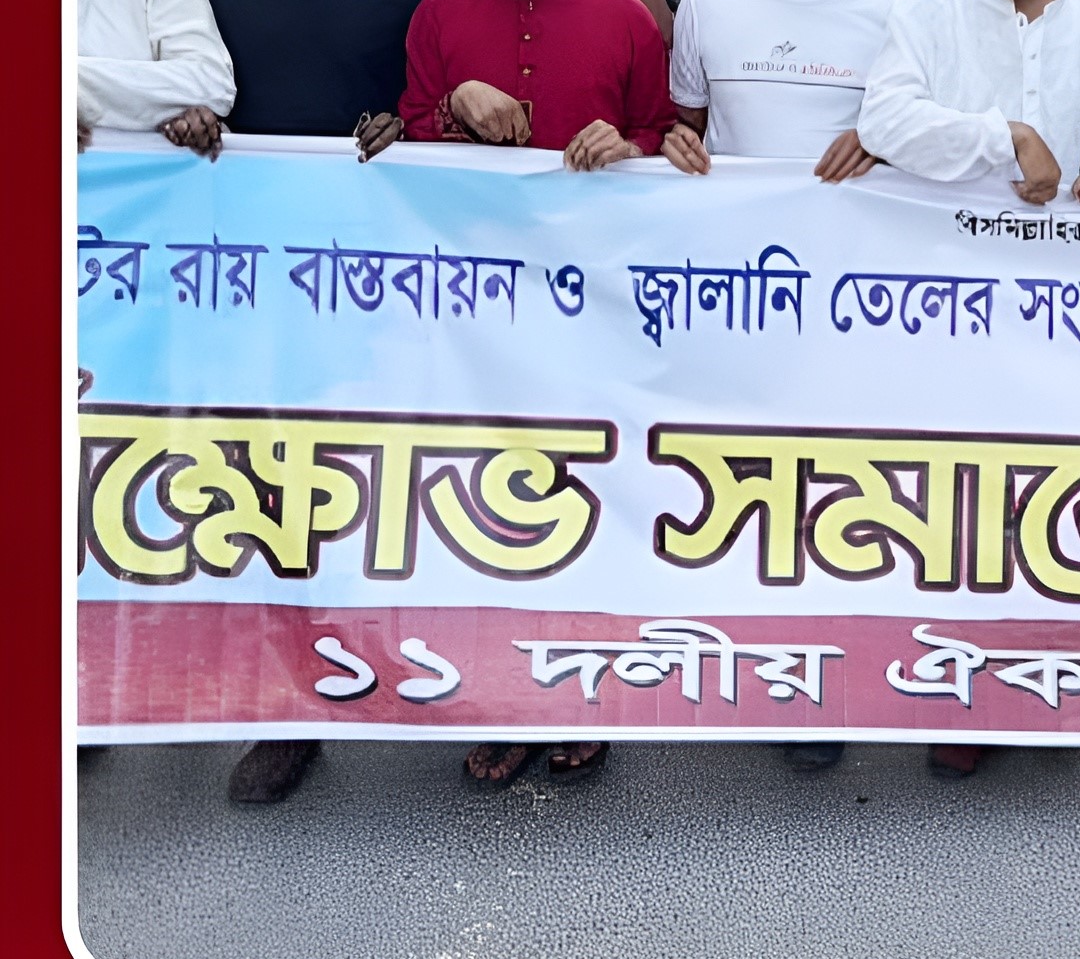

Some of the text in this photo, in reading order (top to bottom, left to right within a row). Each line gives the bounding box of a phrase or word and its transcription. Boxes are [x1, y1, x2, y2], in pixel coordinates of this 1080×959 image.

[165, 232, 269, 311] রায়
[283, 238, 525, 326] বাস্তবায়ন
[545, 263, 585, 317] ও
[628, 244, 811, 347] জ্বালানি
[830, 271, 1000, 338] তেলের
[77, 366, 620, 583] ক্ষোভ
[312, 635, 463, 704] ১১
[511, 618, 846, 706] দলীয়
